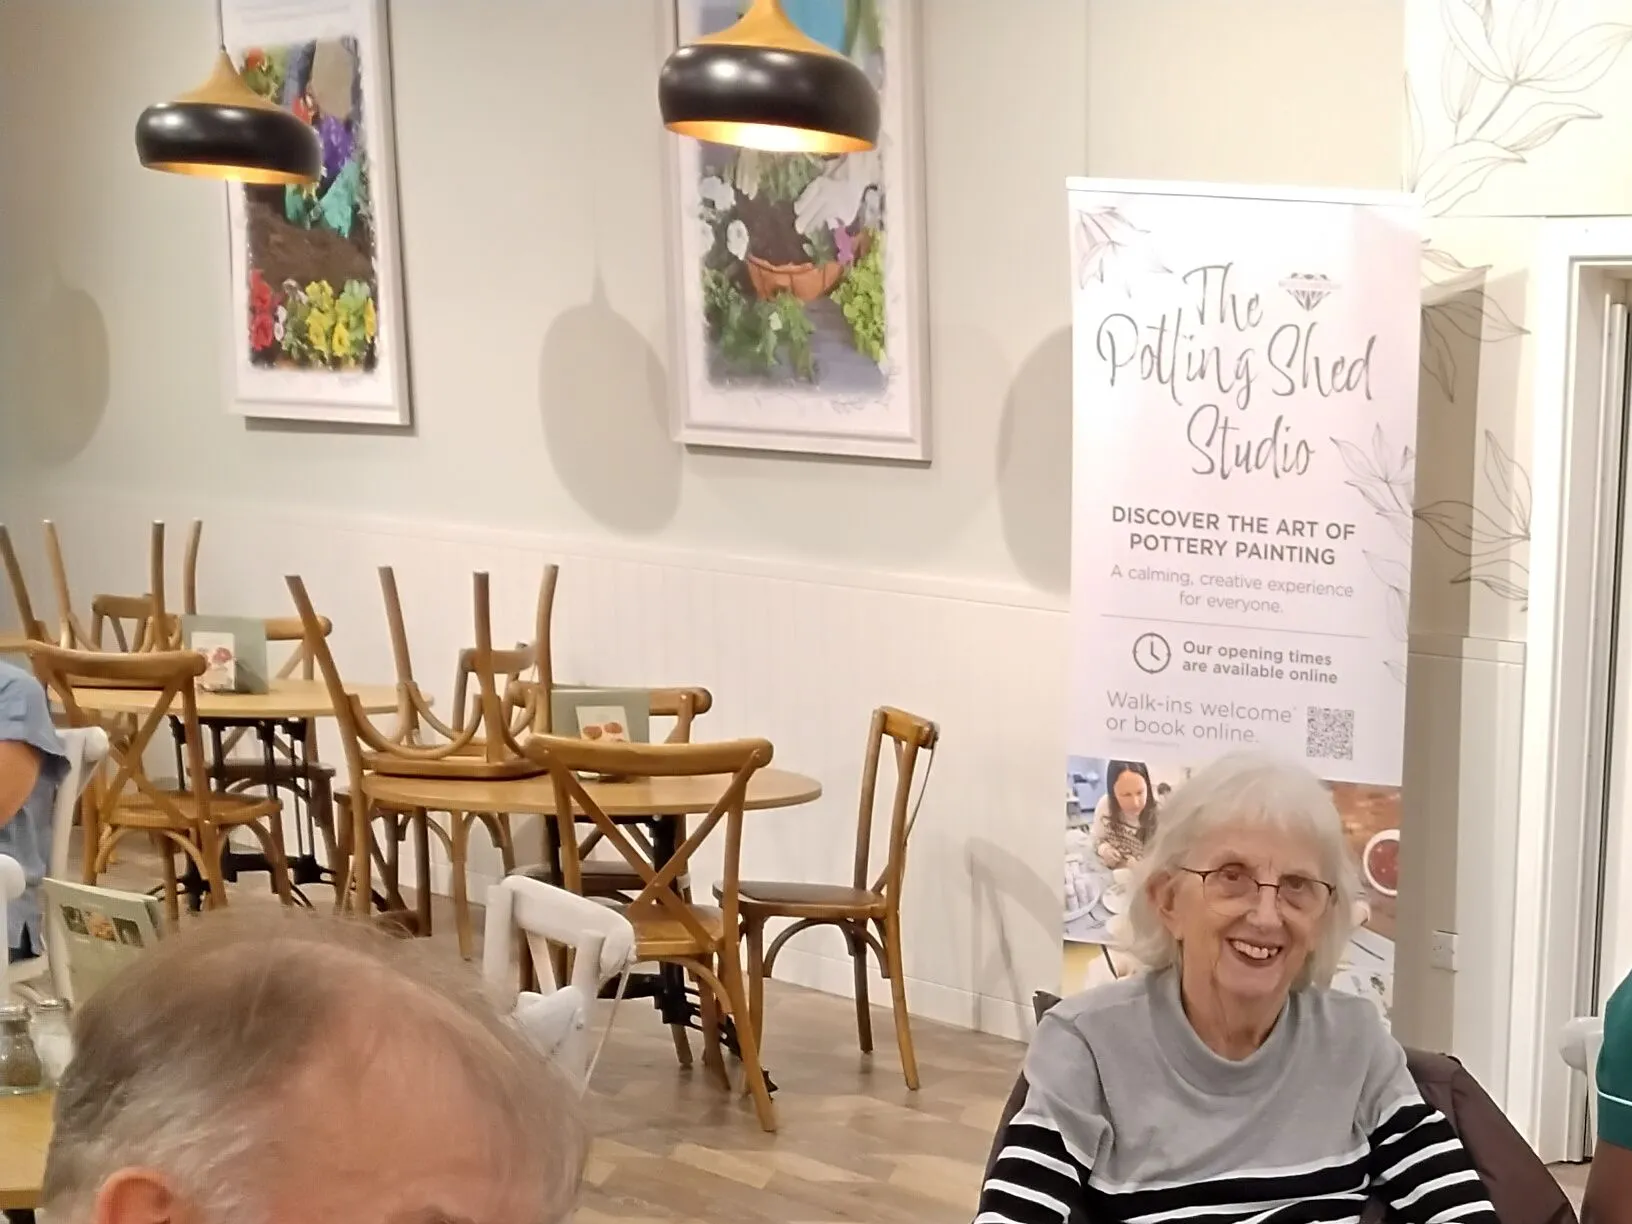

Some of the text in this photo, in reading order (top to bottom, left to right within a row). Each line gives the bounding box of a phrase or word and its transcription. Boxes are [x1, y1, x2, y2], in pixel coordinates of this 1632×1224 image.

[1182, 261, 1263, 331] The
[1097, 308, 1376, 410] Potting Shed
[1187, 404, 1315, 480] Studio
[1112, 506, 1356, 541] DISCOVER THE ART OF
[1130, 533, 1336, 565] POTTERY PAINTING
[1110, 564, 1354, 598] A calming, creative experience
[1179, 592, 1284, 614] for everyone.
[1183, 640, 1332, 666] Our opening times
[1182, 660, 1338, 685] are available online
[1106, 690, 1193, 716] Walk-ins
[1106, 716, 1125, 731] or
[1134, 714, 1186, 736] book
[1192, 722, 1260, 743] online.
